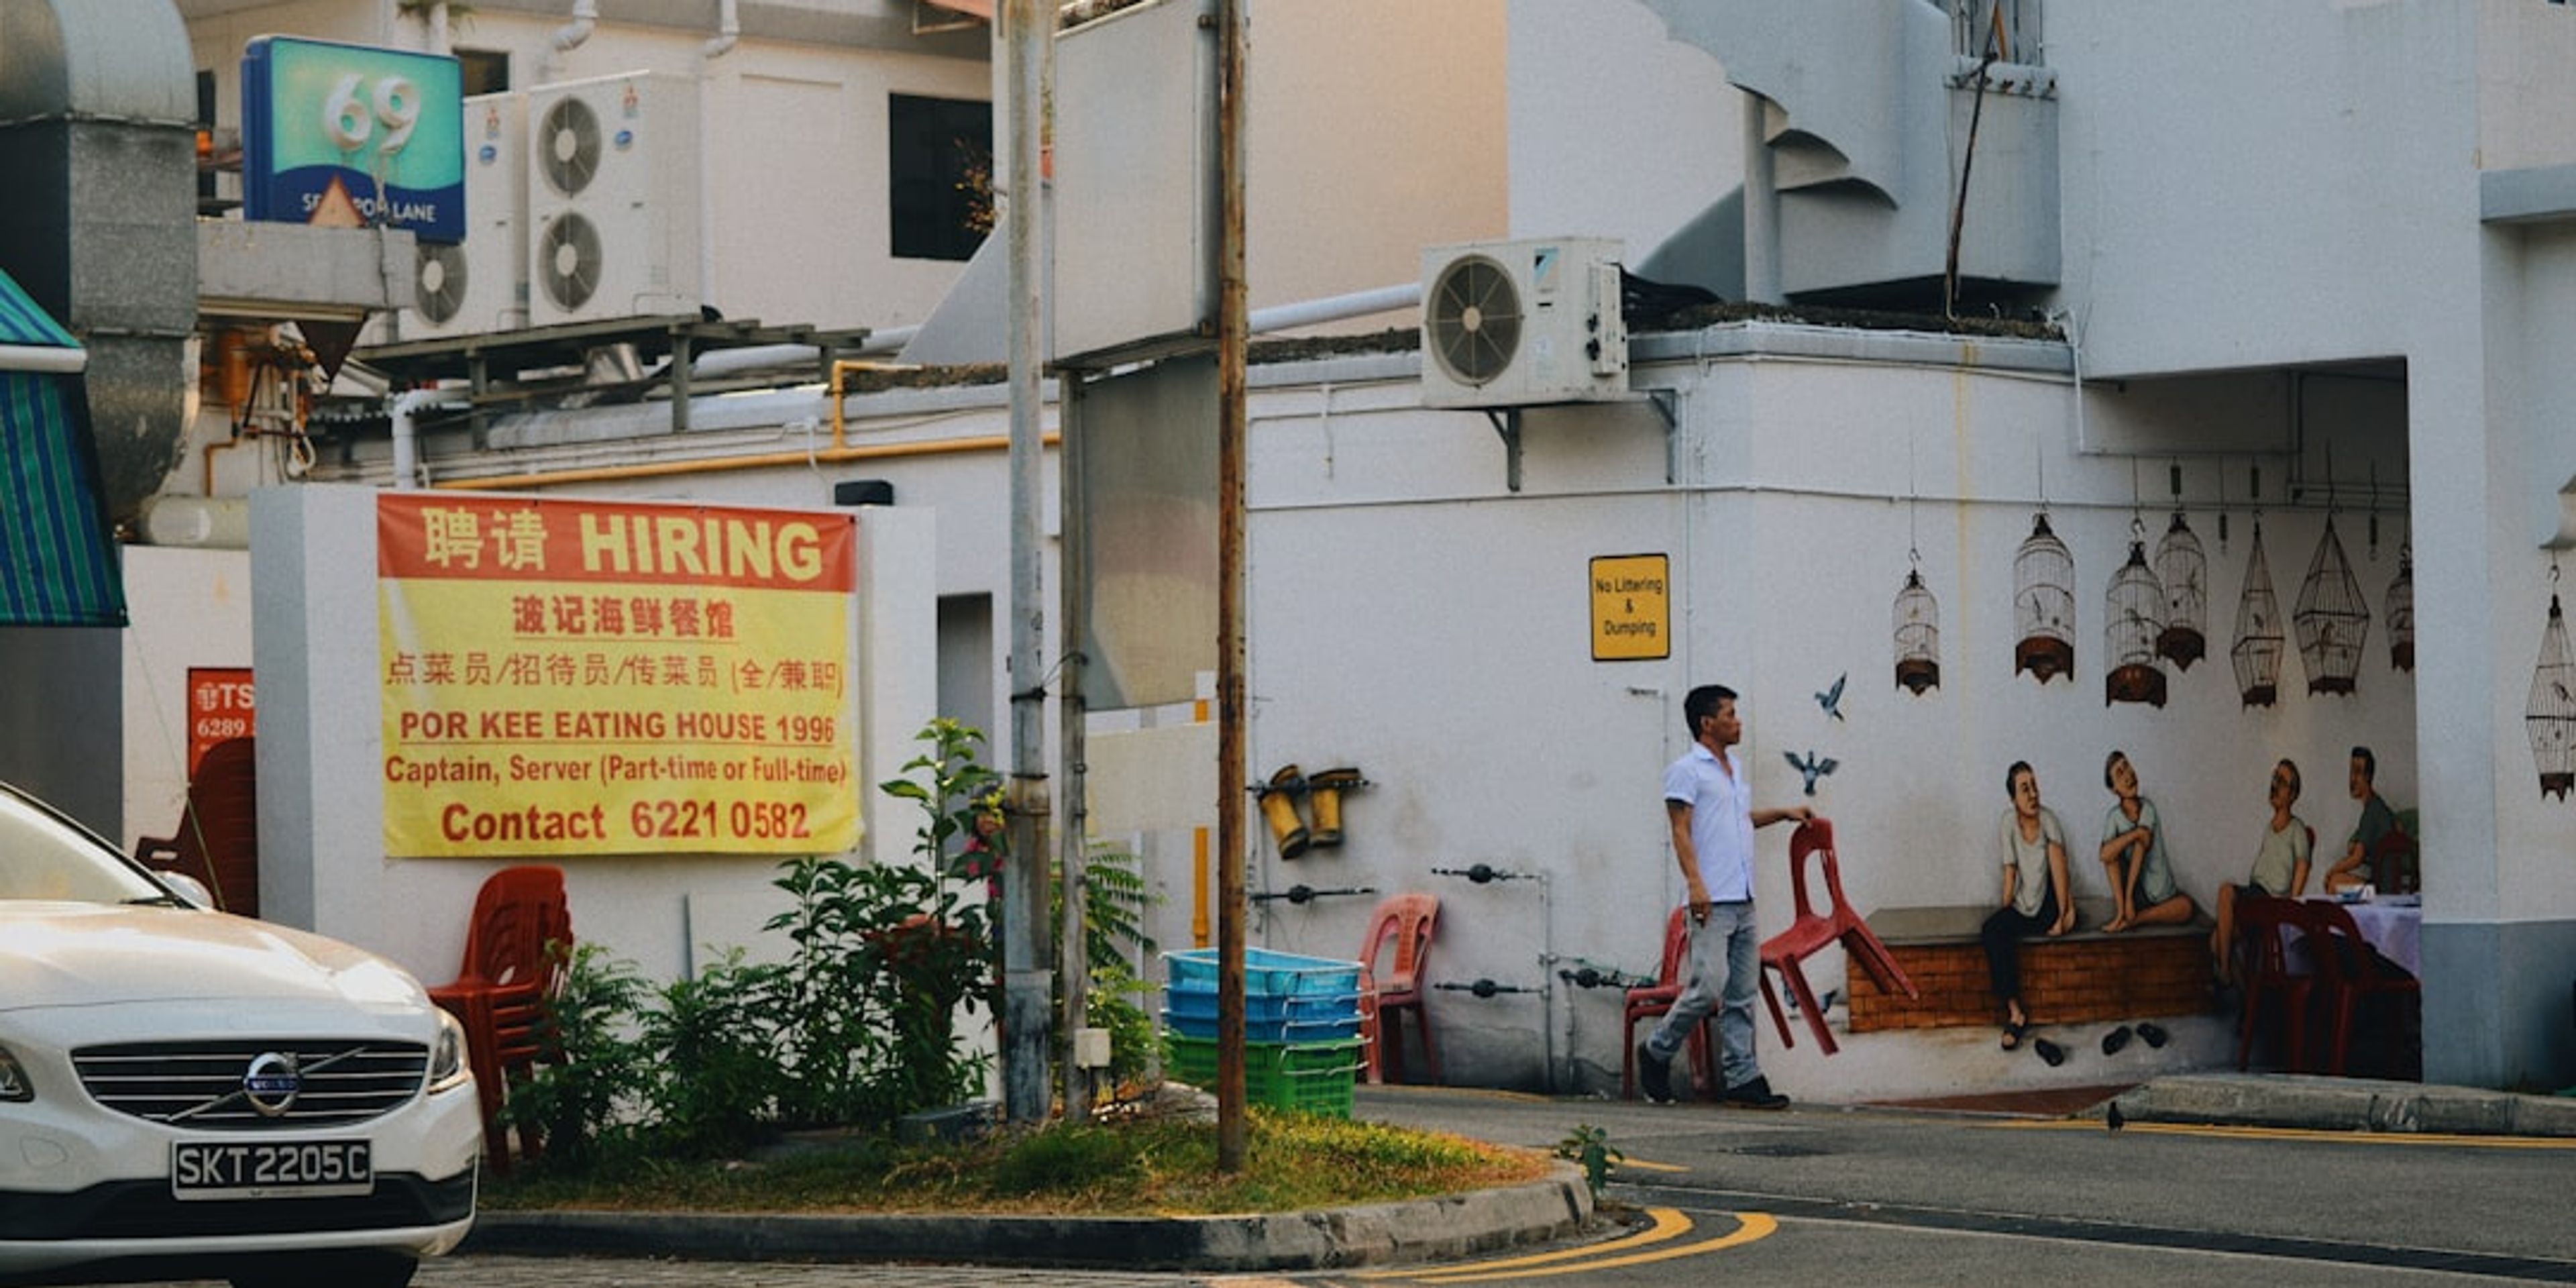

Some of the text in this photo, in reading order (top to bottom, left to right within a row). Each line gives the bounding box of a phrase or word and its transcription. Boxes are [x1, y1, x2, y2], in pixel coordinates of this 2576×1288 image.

[324, 73, 421, 154] 69
[393, 202, 437, 223] LANE
[421, 507, 822, 581] 聘请 HIRING
[1596, 576, 1663, 595] No Littering
[1604, 619, 1656, 637] Dumping
[197, 718, 246, 738] 6289
[400, 711, 835, 743] POR KEE EATING HOUSE 1996
[385, 753, 847, 789] Captain, Server (Part-time or Full-time)
[441, 800, 810, 841] Contact 6221 0582
